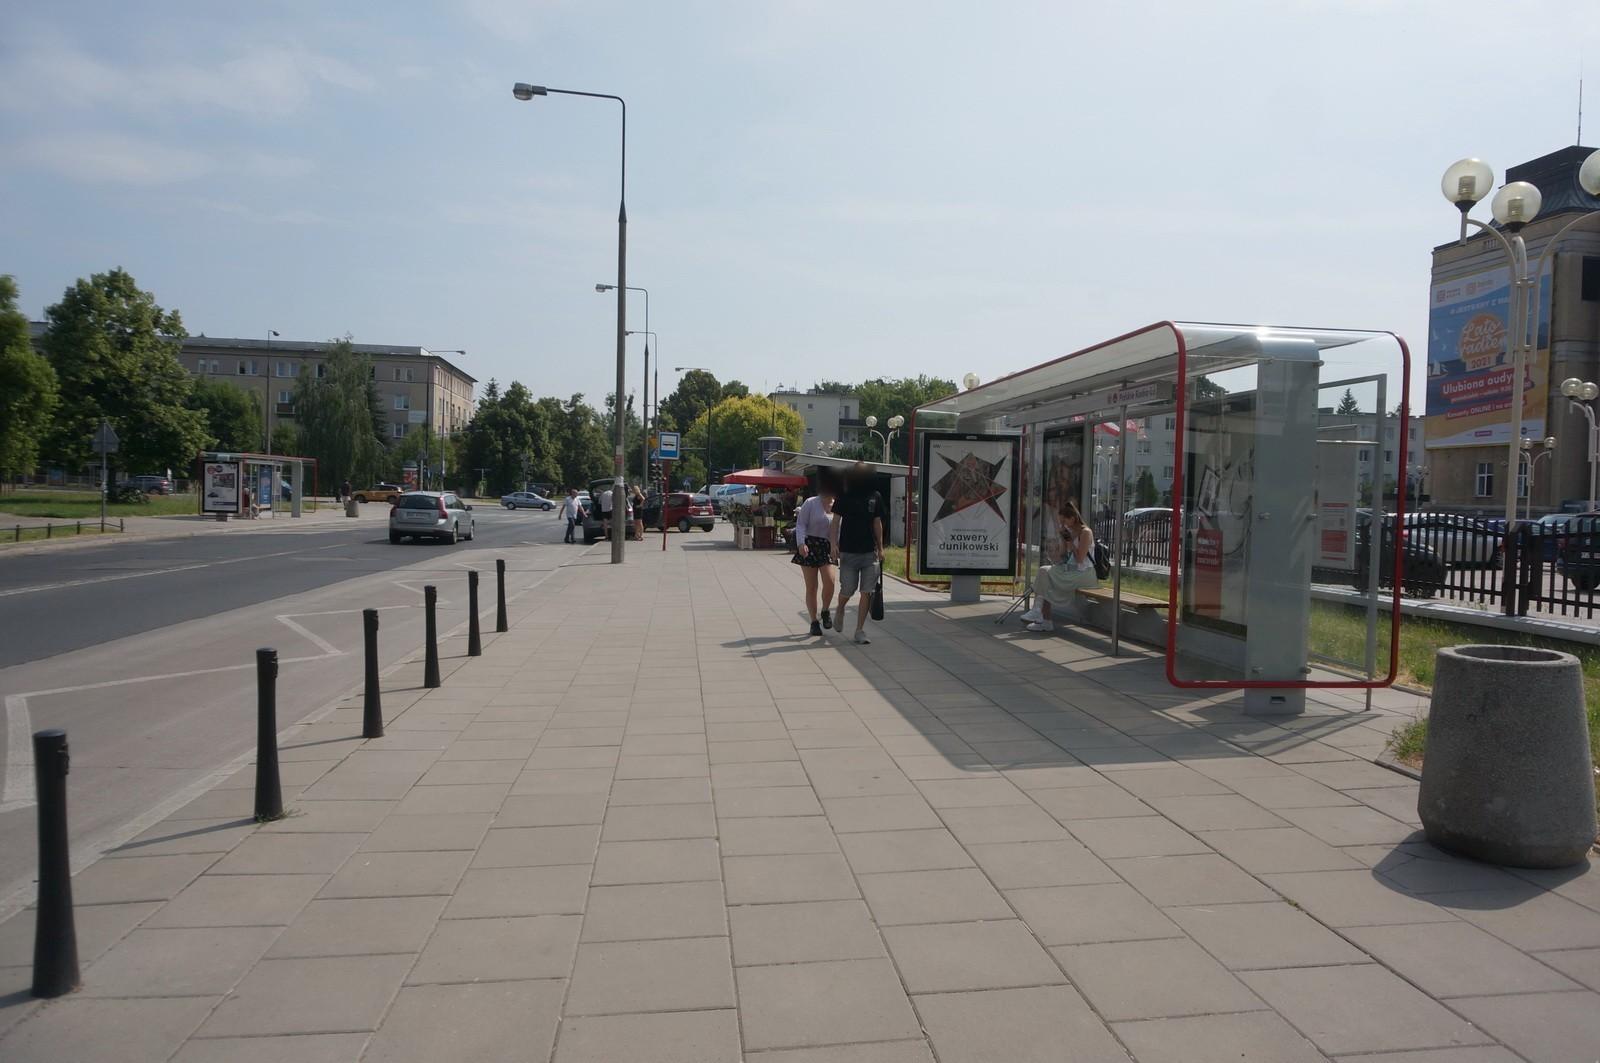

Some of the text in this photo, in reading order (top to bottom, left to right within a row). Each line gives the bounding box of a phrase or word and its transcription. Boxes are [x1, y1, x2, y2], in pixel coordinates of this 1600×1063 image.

[1442, 379, 1485, 394] Ulubiona
[950, 534, 988, 543] xawery
[939, 542, 999, 551] dunikowski
